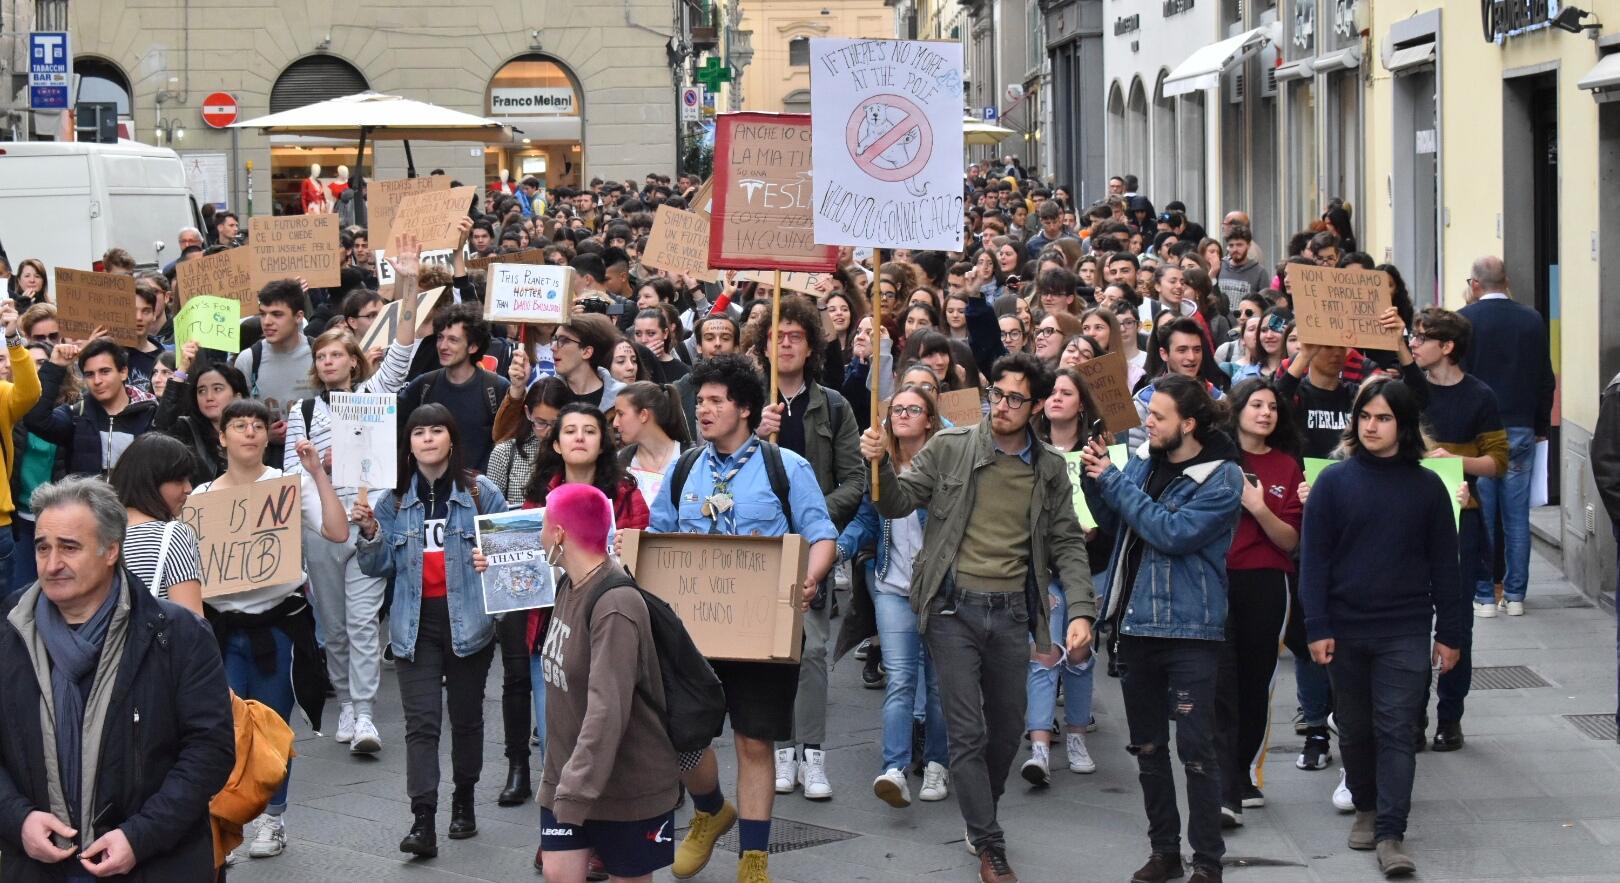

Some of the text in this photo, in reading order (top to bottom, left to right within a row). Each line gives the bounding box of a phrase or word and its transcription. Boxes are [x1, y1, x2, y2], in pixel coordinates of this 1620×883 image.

[820, 40, 948, 77] IF THERE'S NO MORE
[33, 73, 52, 81] BAR
[851, 65, 939, 105] AT THE POLE
[492, 95, 572, 107] Franco Melani
[986, 107, 994, 119] P
[734, 124, 778, 141] ANCHE
[731, 148, 752, 166] LA
[756, 149, 784, 167] MIA
[274, 217, 310, 230] FUTURO
[312, 217, 330, 228] CHE
[196, 253, 231, 272] NATURA
[260, 252, 338, 272] CAMBIAMENTO!
[500, 269, 560, 288] THIS PLANET IS
[1301, 271, 1382, 287] NON VOGLIAMO
[513, 287, 543, 299] HOTTER
[1304, 285, 1318, 298] LE
[1327, 286, 1364, 301] PAROLE
[213, 302, 231, 312] FOR
[495, 300, 509, 309] THAN
[1352, 302, 1376, 314] NON
[180, 485, 296, 541] RE IS NO
[491, 551, 534, 564] THAT'S
[648, 546, 692, 570] TUTTO
[735, 549, 768, 572] RIFARE
[678, 576, 737, 595] DUE VOLTE
[692, 600, 734, 626] MONDO
[541, 828, 573, 836] LEGEA
